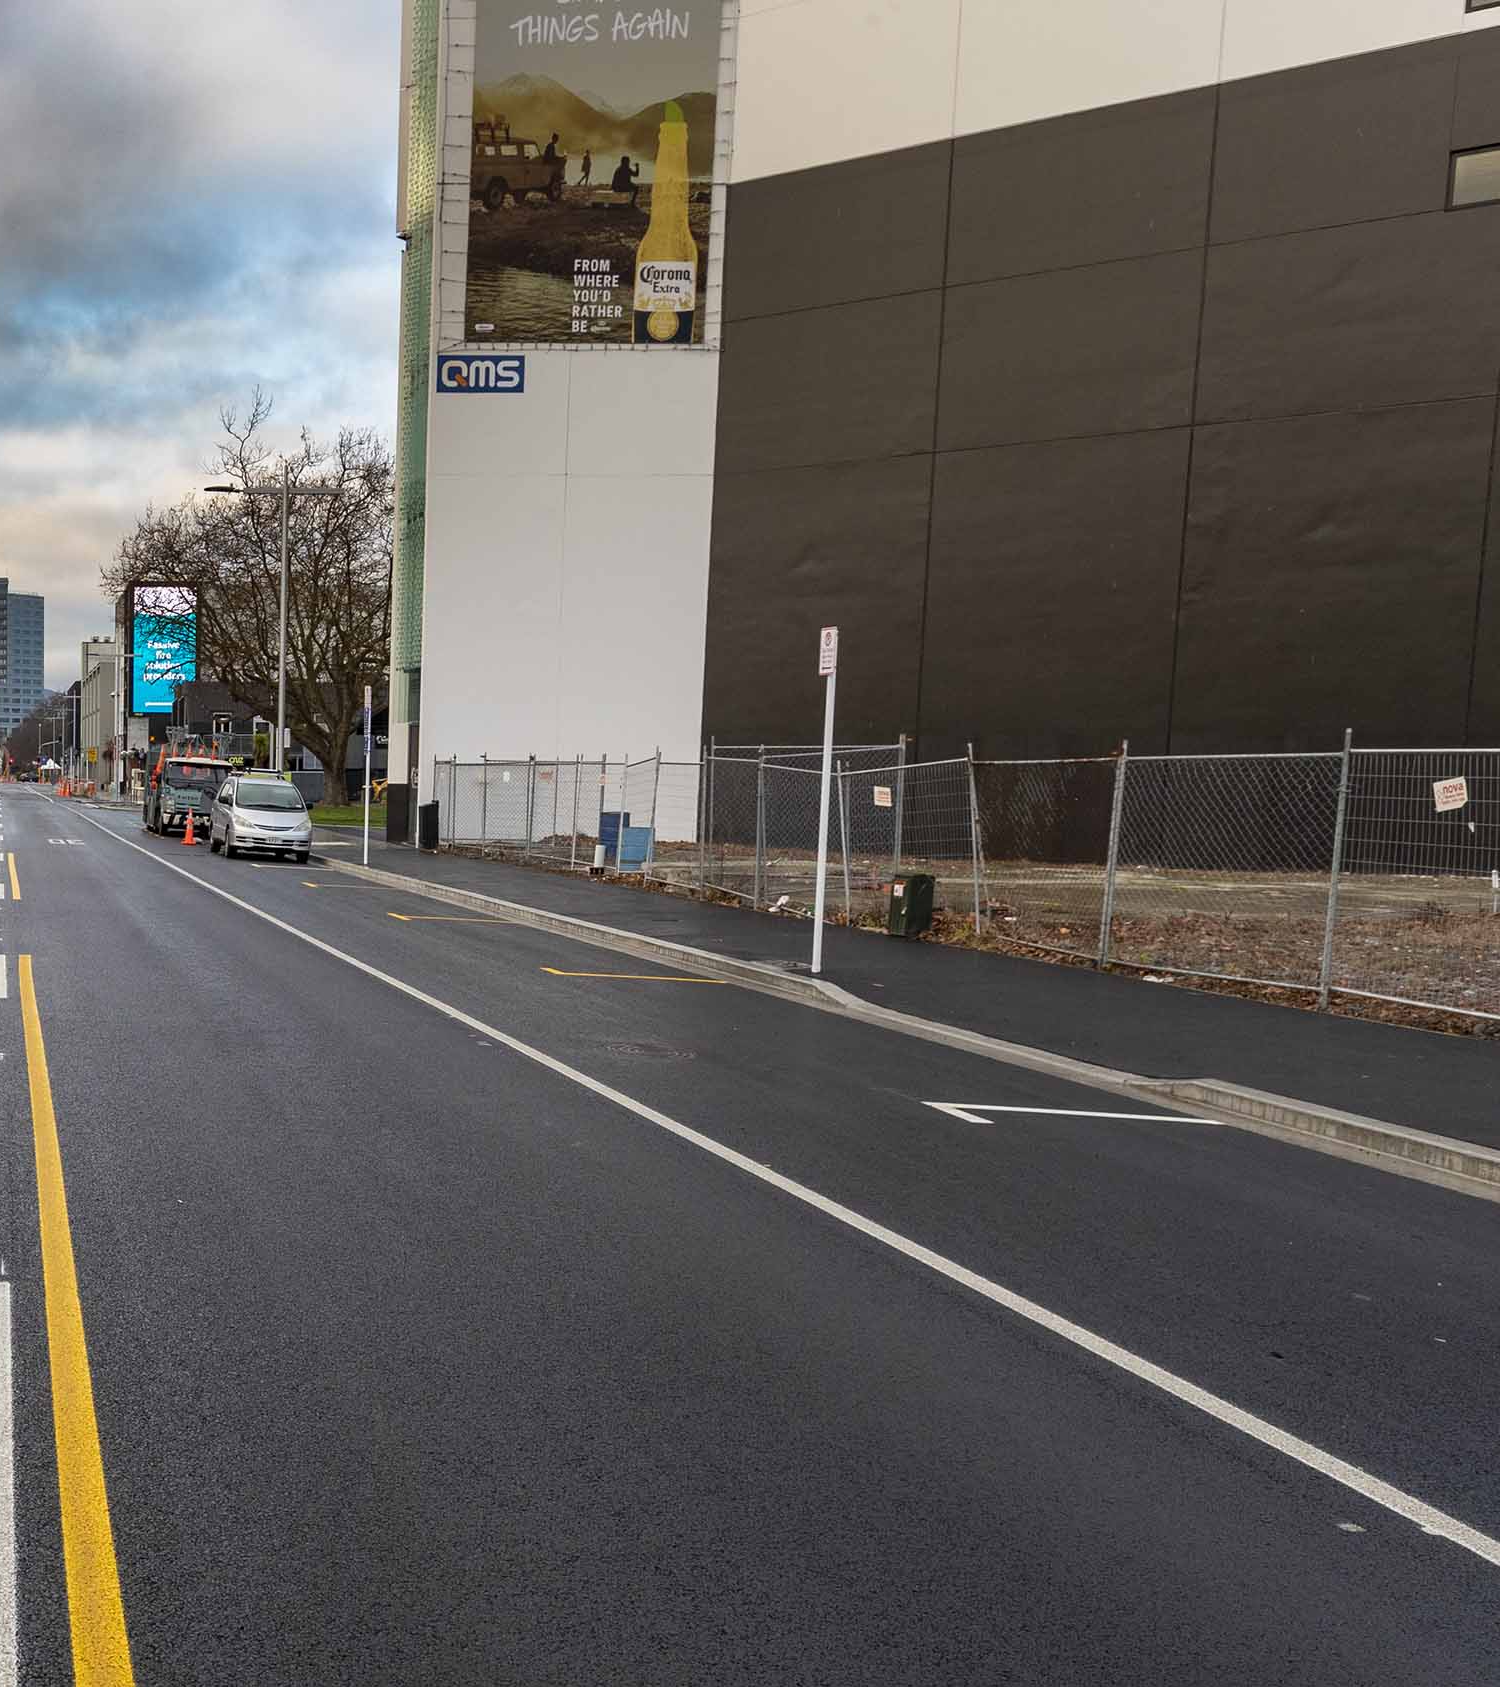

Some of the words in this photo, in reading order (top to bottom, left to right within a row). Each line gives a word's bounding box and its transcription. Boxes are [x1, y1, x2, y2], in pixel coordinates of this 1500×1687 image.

[510, 14, 599, 46] THINGS
[612, 8, 690, 41] AGAIN
[573, 259, 611, 273] FROM
[573, 274, 620, 288] WHERE
[640, 265, 692, 285] Corona
[652, 281, 680, 294] Extra
[572, 289, 611, 302] YOU'D
[572, 304, 623, 318] RATHER
[571, 320, 588, 333] BE
[441, 360, 520, 387] QMS
[155, 651, 172, 660] fire
